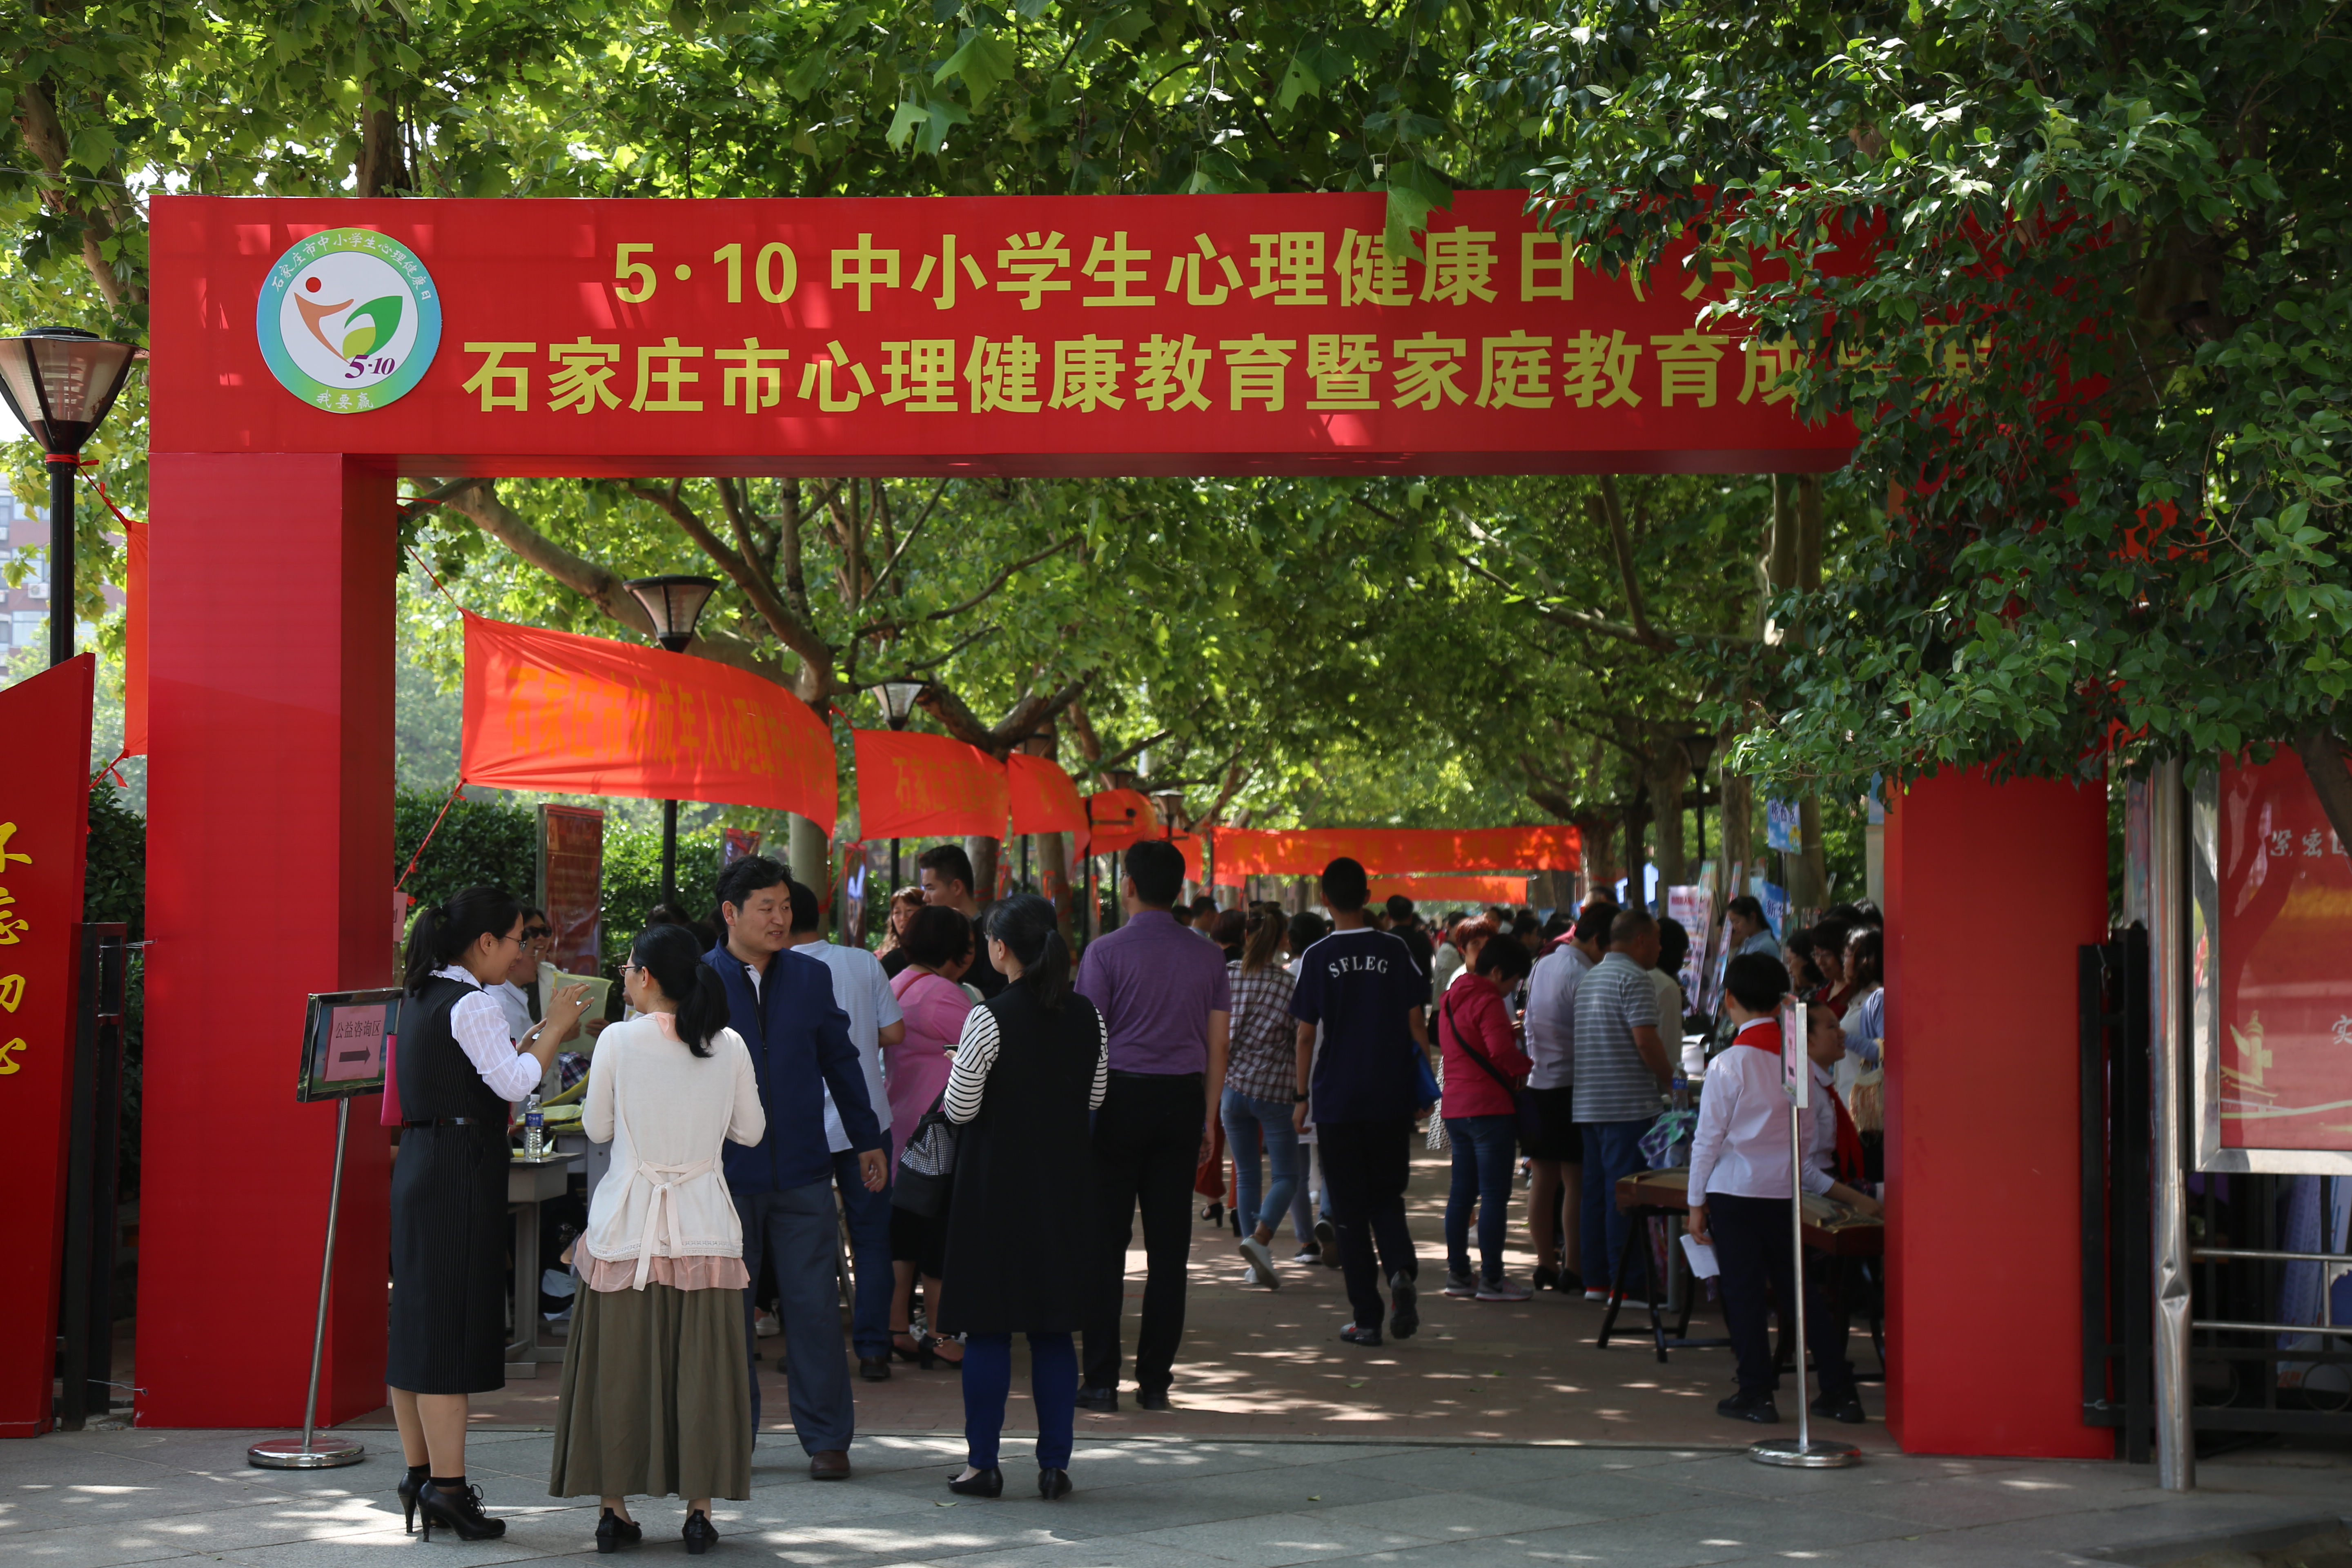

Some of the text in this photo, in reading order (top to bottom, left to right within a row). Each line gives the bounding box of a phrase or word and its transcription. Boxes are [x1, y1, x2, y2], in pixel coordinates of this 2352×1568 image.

[271, 232, 432, 301] 石家庄市中小学生心理健康日
[316, 389, 374, 410] 我要赢
[335, 1020, 381, 1039] 公益咨询区
